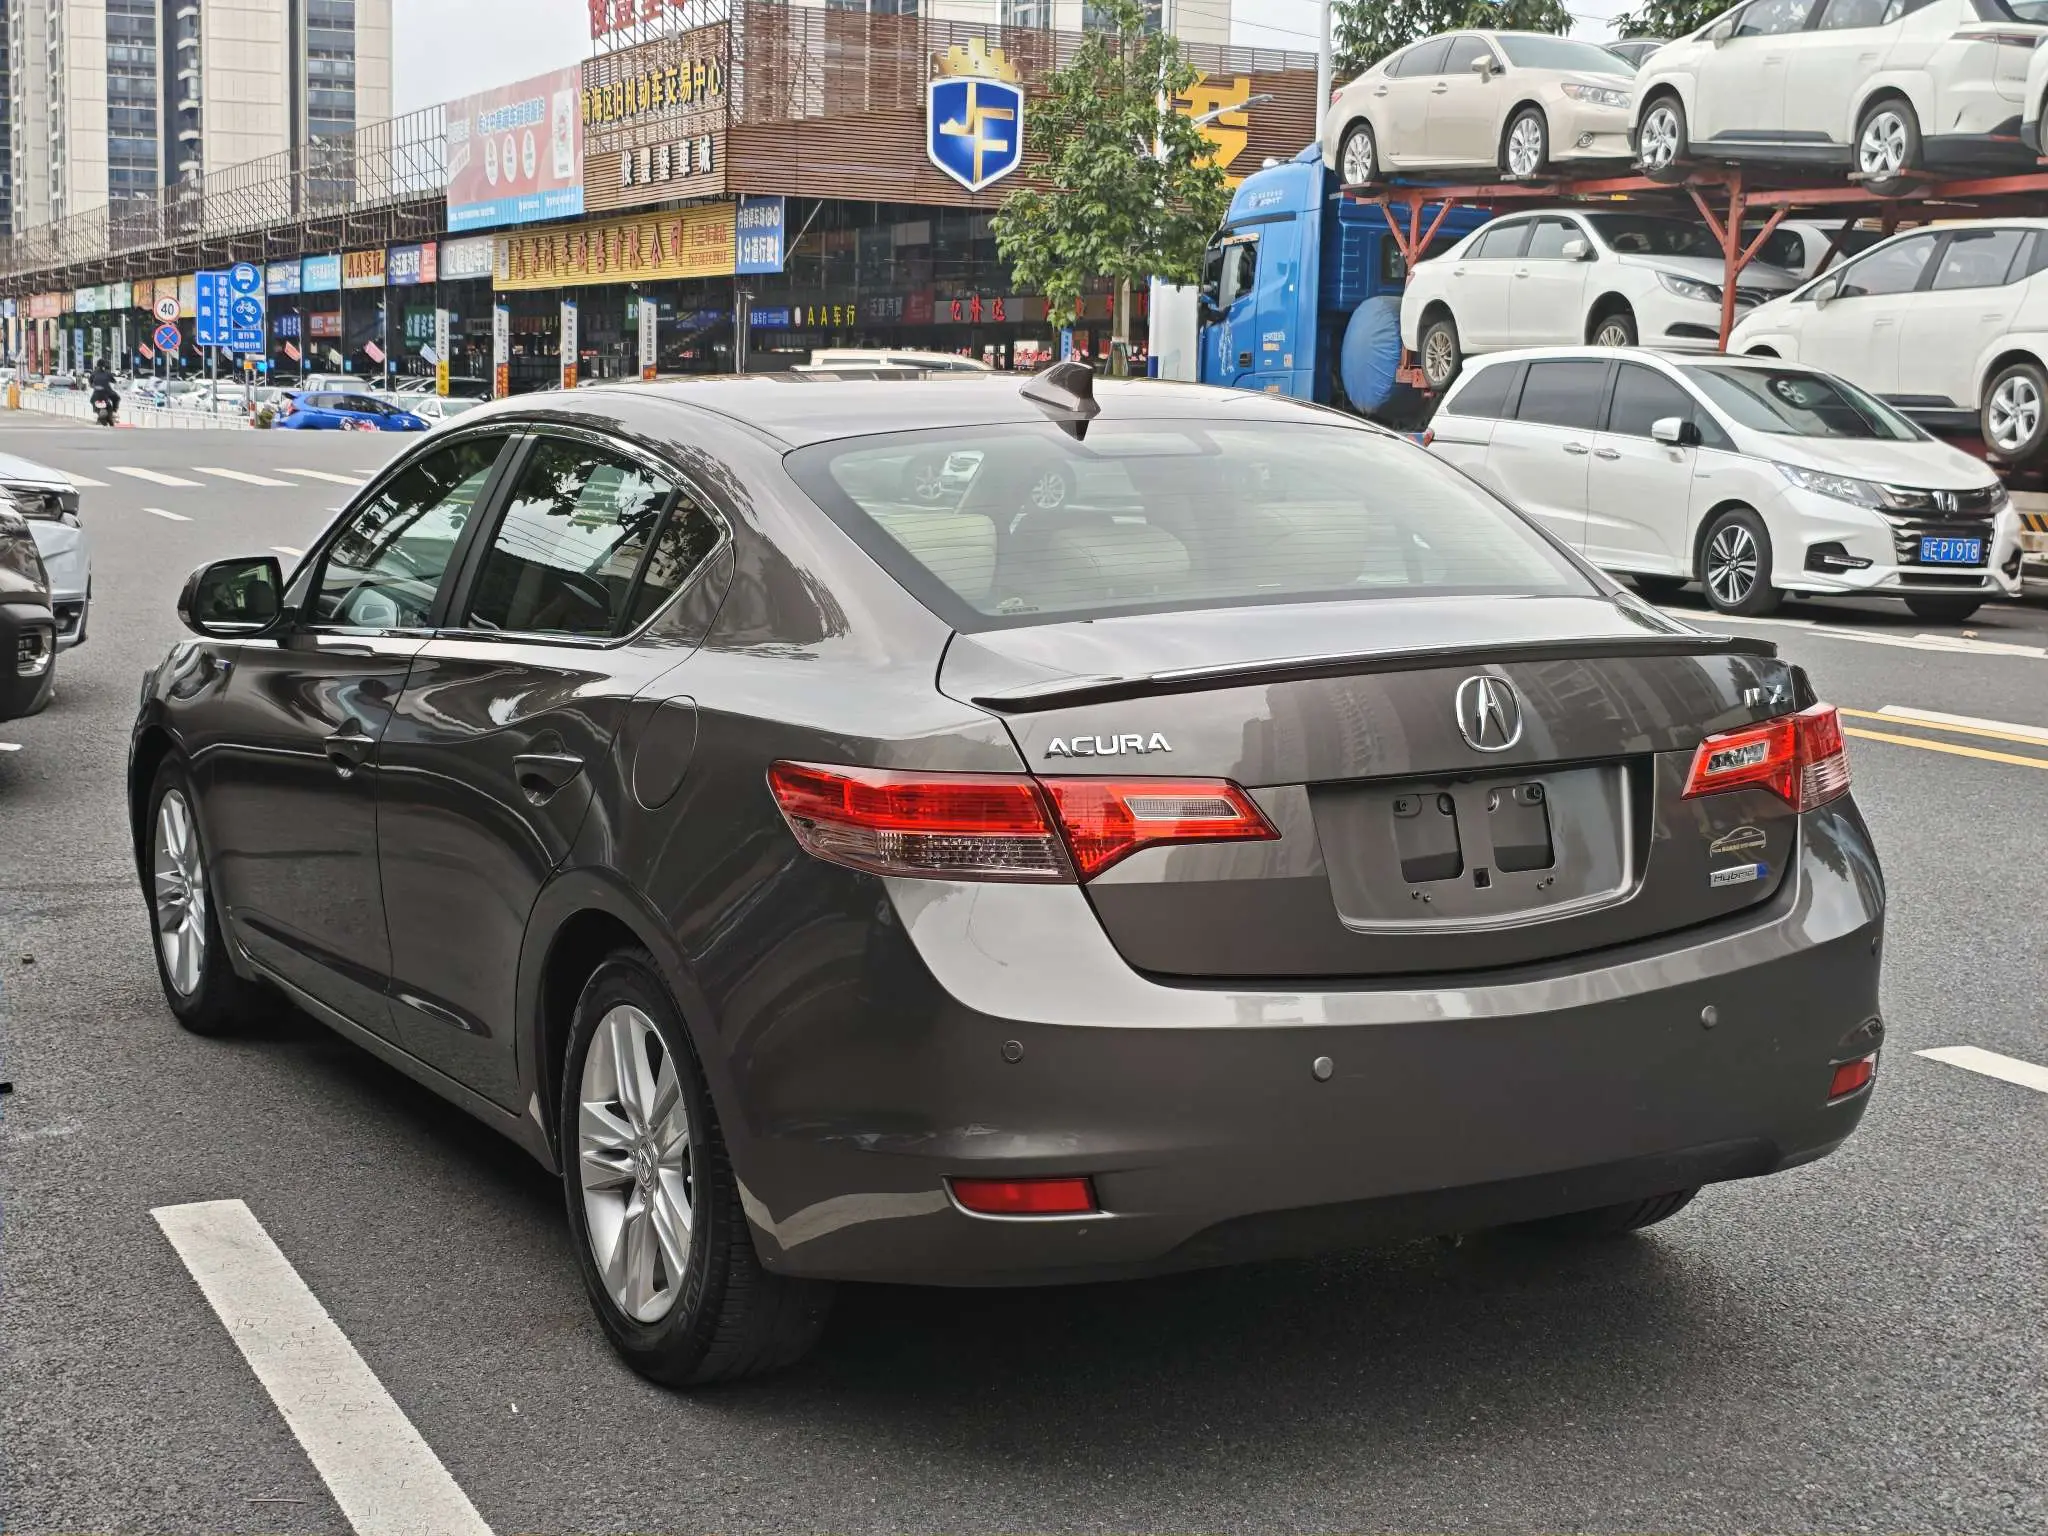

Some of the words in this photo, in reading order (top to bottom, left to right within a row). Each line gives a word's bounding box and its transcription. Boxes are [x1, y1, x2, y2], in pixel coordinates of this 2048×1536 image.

[581, 55, 722, 125] 南海区旧机动车交易中心
[160, 303, 175, 316] 40
[807, 304, 856, 328] AA车行
[1044, 731, 1173, 760] ACURA
